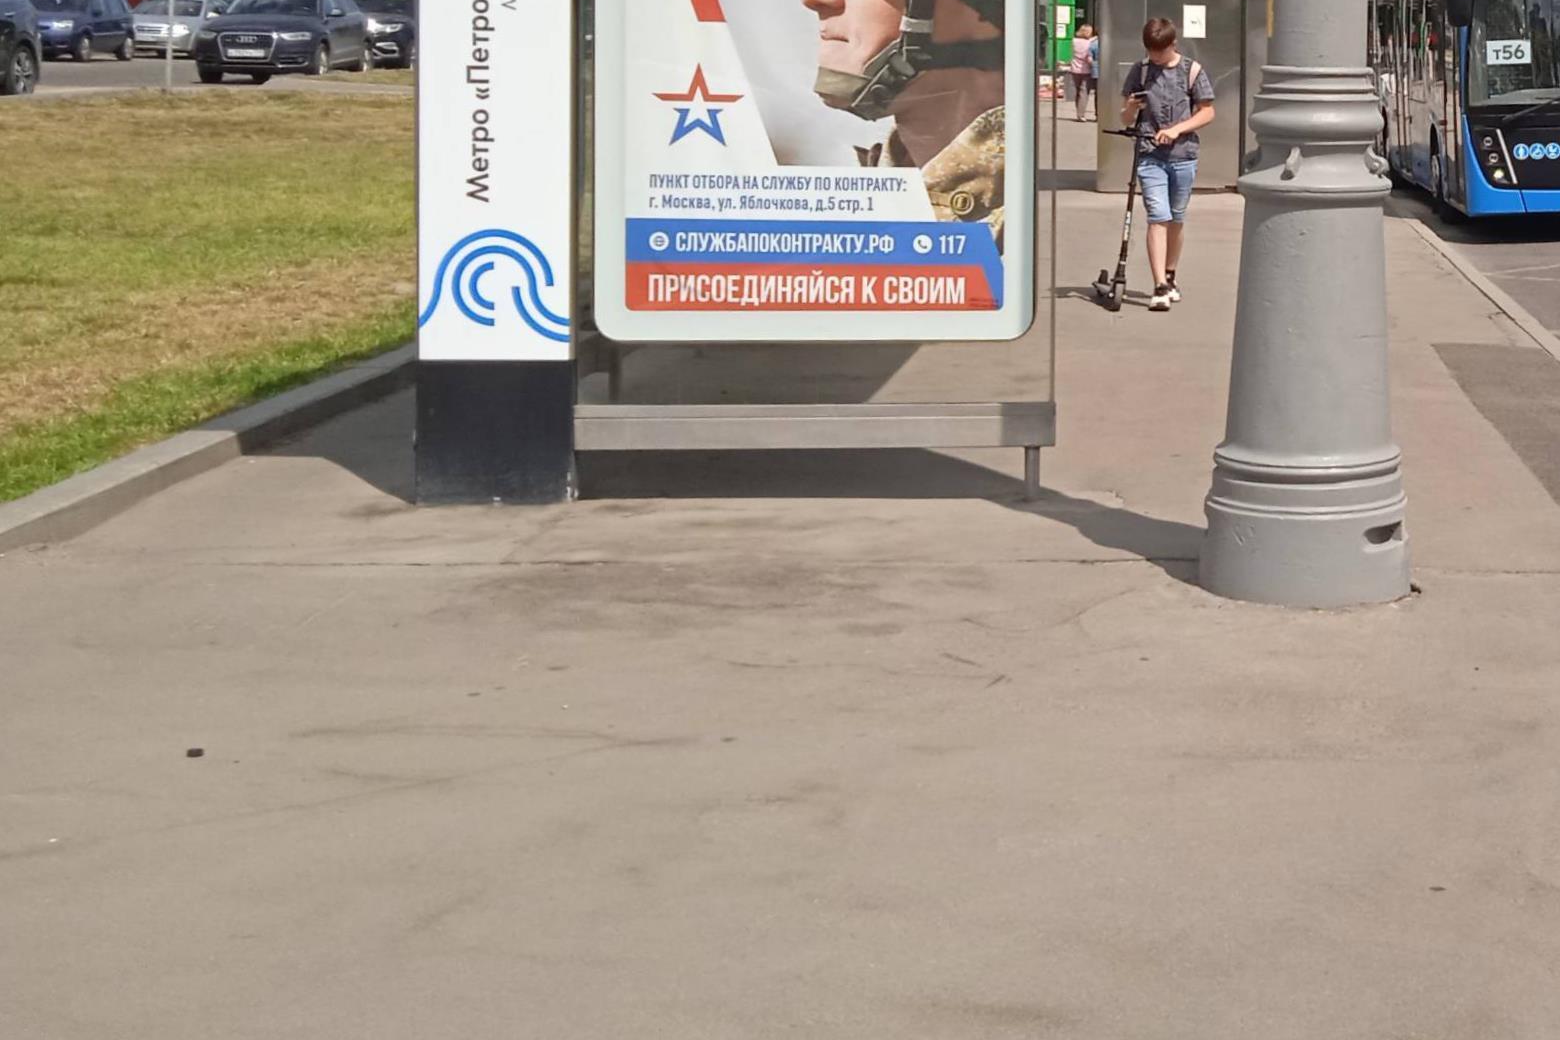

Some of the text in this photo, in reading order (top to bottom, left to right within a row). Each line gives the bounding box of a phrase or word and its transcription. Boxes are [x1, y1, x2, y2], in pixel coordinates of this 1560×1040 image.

[466, 108, 495, 204] Метро
[648, 173, 908, 193] ПУНКТ ОТБОРА НА СЛУЖБУ ПО КОНТРАКТУ:
[648, 196, 659, 209] г.
[661, 194, 716, 211] Москва,
[717, 198, 737, 212] ул.
[739, 195, 813, 213] Яблочкова,
[837, 199, 864, 214] стр.
[866, 197, 874, 211] 1
[675, 232, 895, 254] СЛУЖБАПОКОНТРАКТУ.РФ
[939, 235, 966, 254] 117
[648, 270, 966, 306] ПРИСОЕДИНЯЙСЯ К СВОИМ
